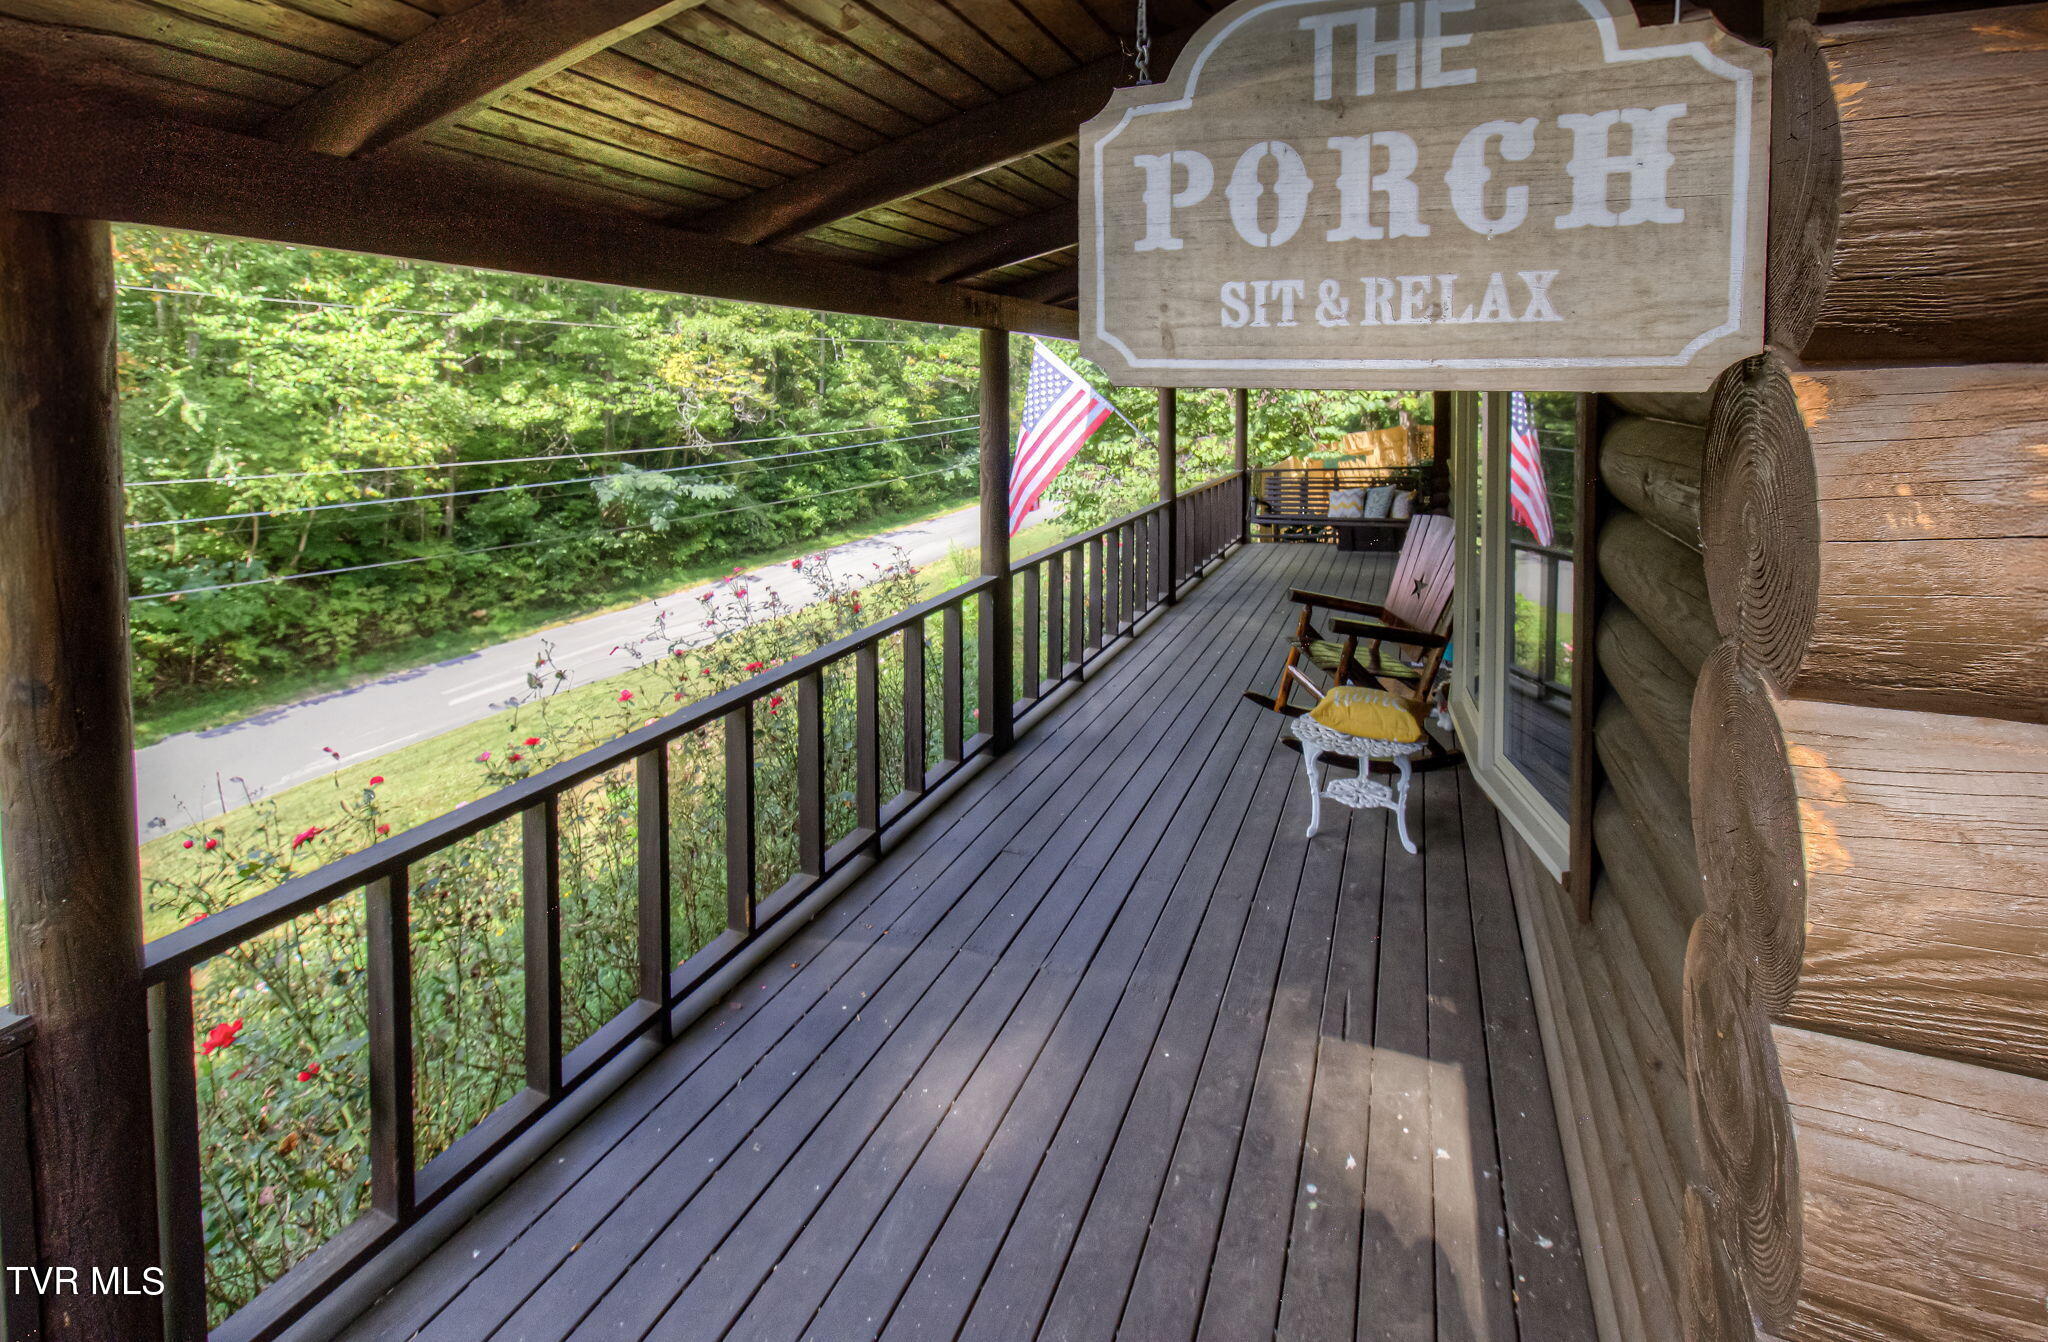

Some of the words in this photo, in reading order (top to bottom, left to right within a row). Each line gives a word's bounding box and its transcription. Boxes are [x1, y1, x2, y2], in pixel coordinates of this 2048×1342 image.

[1298, 0, 1477, 101] THE
[1133, 103, 1687, 251] PORCH
[1220, 279, 1305, 329] SIT
[1315, 278, 1350, 328] &
[1360, 269, 1564, 326] RELAX
